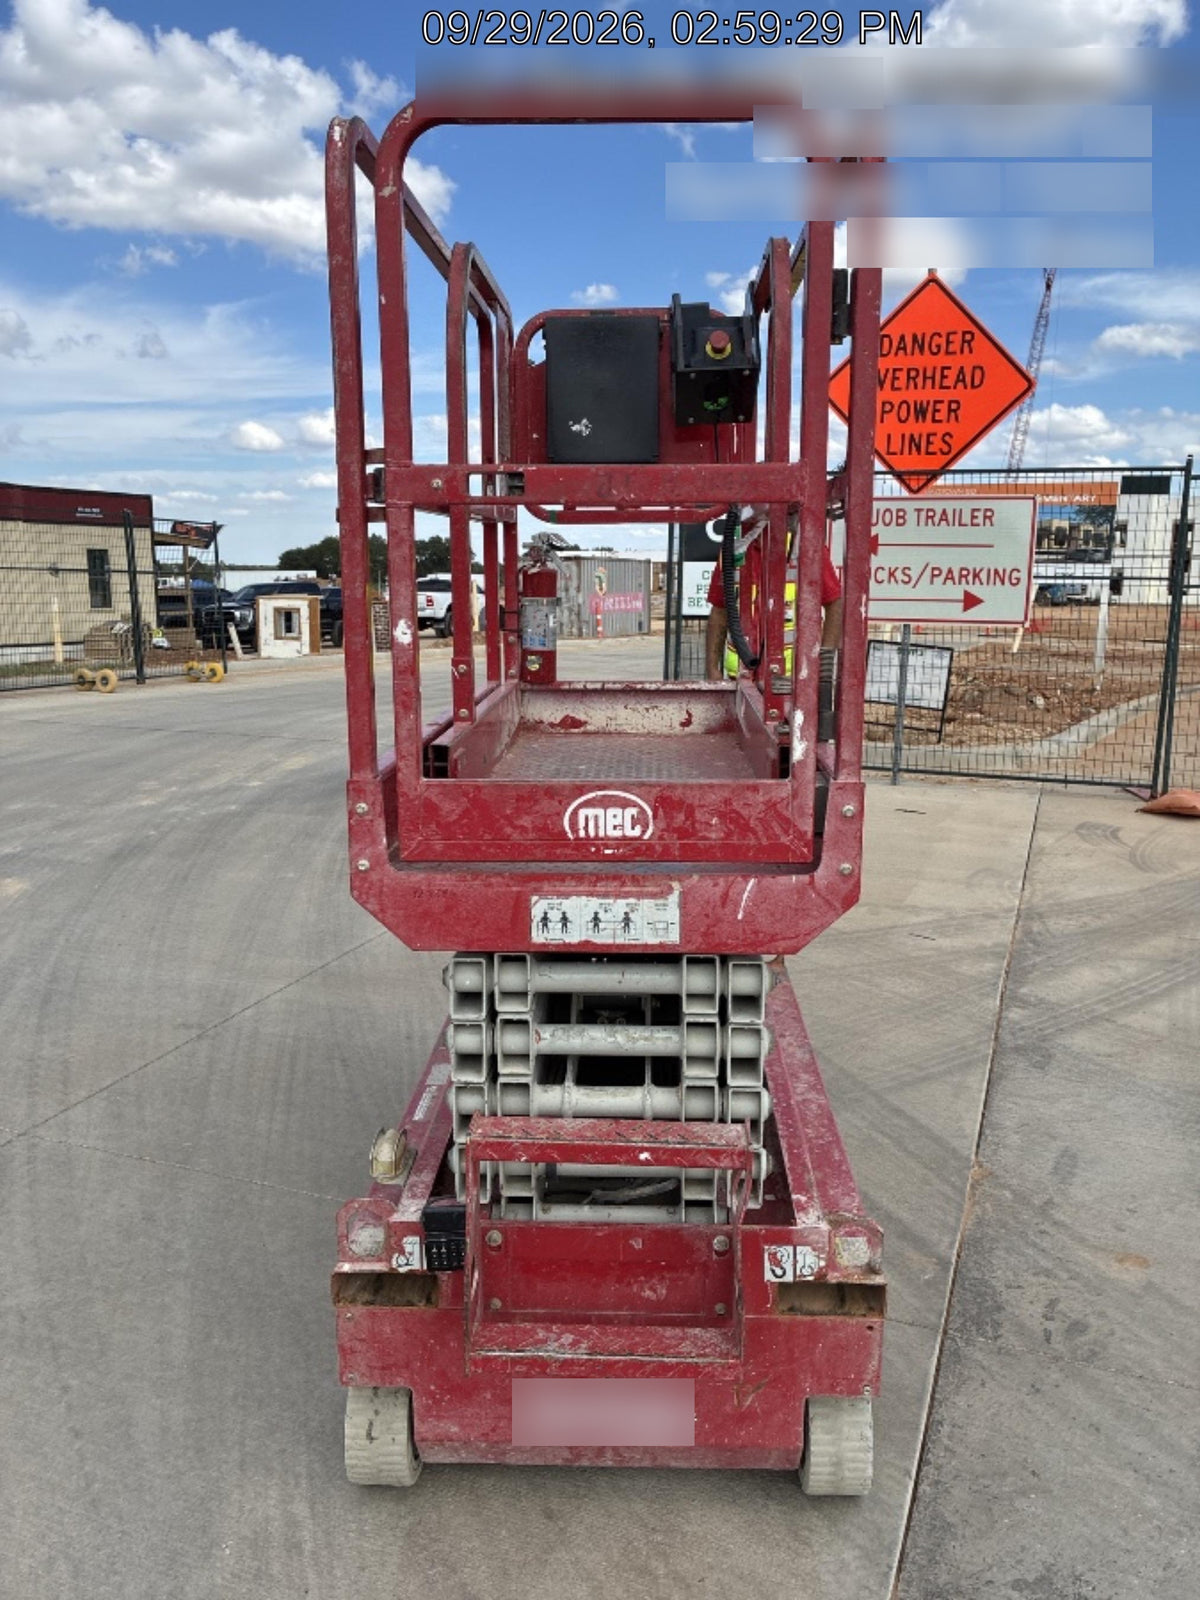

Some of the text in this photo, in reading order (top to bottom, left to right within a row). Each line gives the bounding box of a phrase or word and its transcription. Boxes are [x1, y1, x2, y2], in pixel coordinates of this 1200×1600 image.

[880, 330, 975, 358] DANGER
[878, 365, 985, 391] VERHEAD
[880, 399, 961, 424] POWER
[886, 431, 954, 456] LINES
[871, 508, 995, 527] JOB TRAILER
